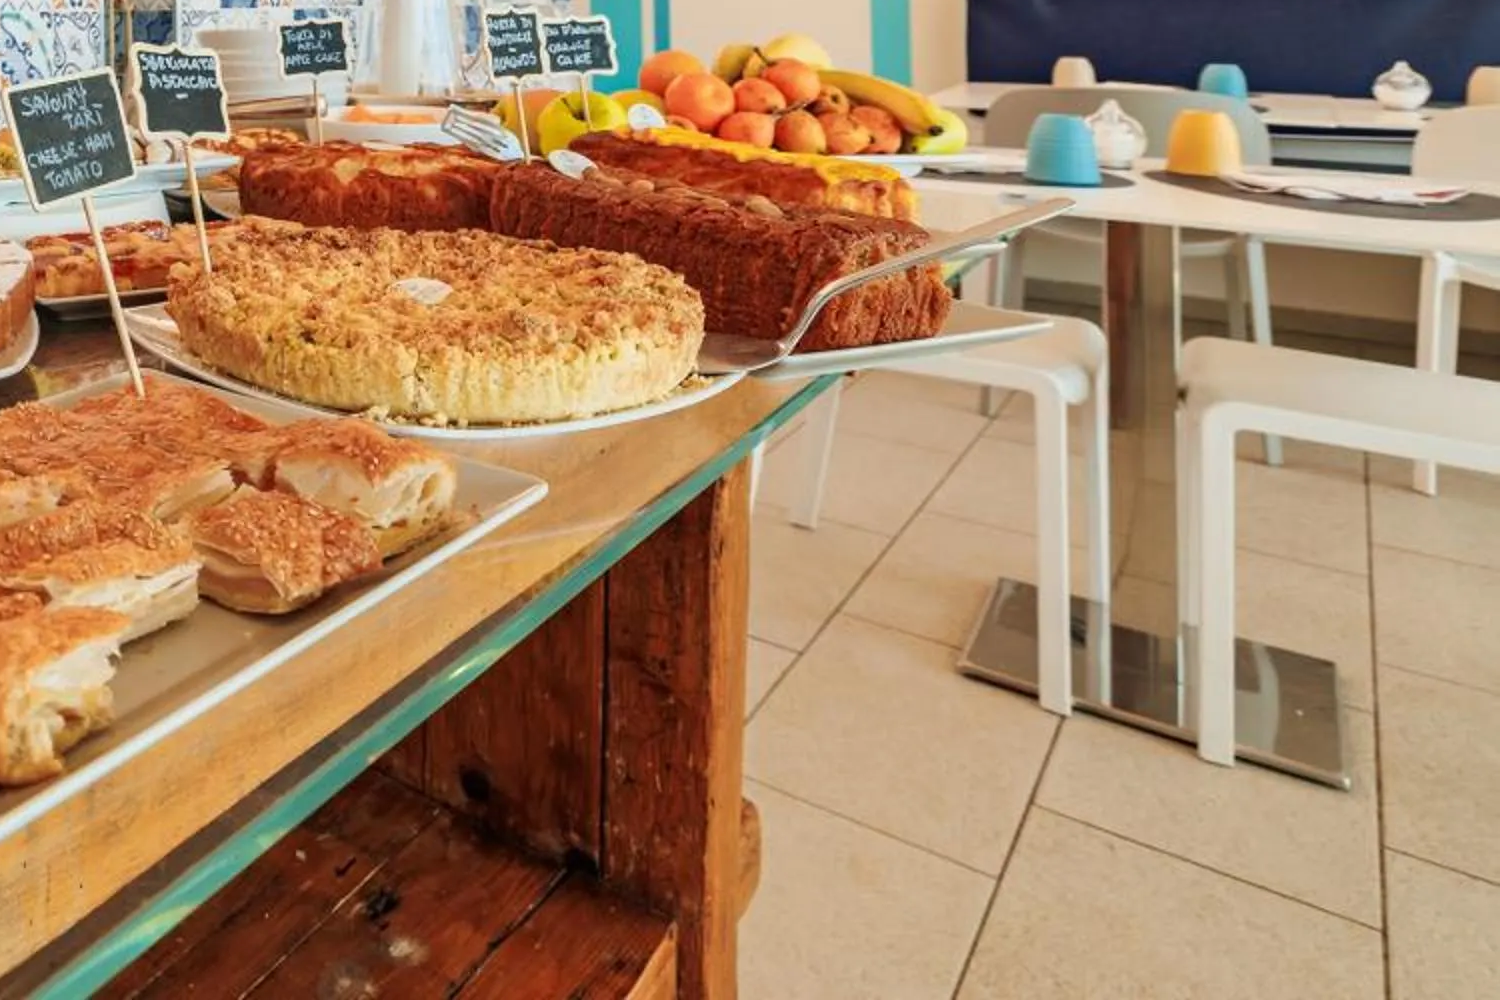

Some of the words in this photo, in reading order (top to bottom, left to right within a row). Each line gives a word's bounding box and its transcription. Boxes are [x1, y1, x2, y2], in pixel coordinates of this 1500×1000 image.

[319, 29, 333, 40] DI
[548, 38, 592, 54] ORANGE
[286, 53, 311, 68] APPLE
[315, 51, 342, 63] CAKE
[557, 52, 594, 67] CAKE
[20, 80, 88, 117] SAVOURY
[62, 103, 104, 130] TART
[44, 160, 104, 191] TOMATO
